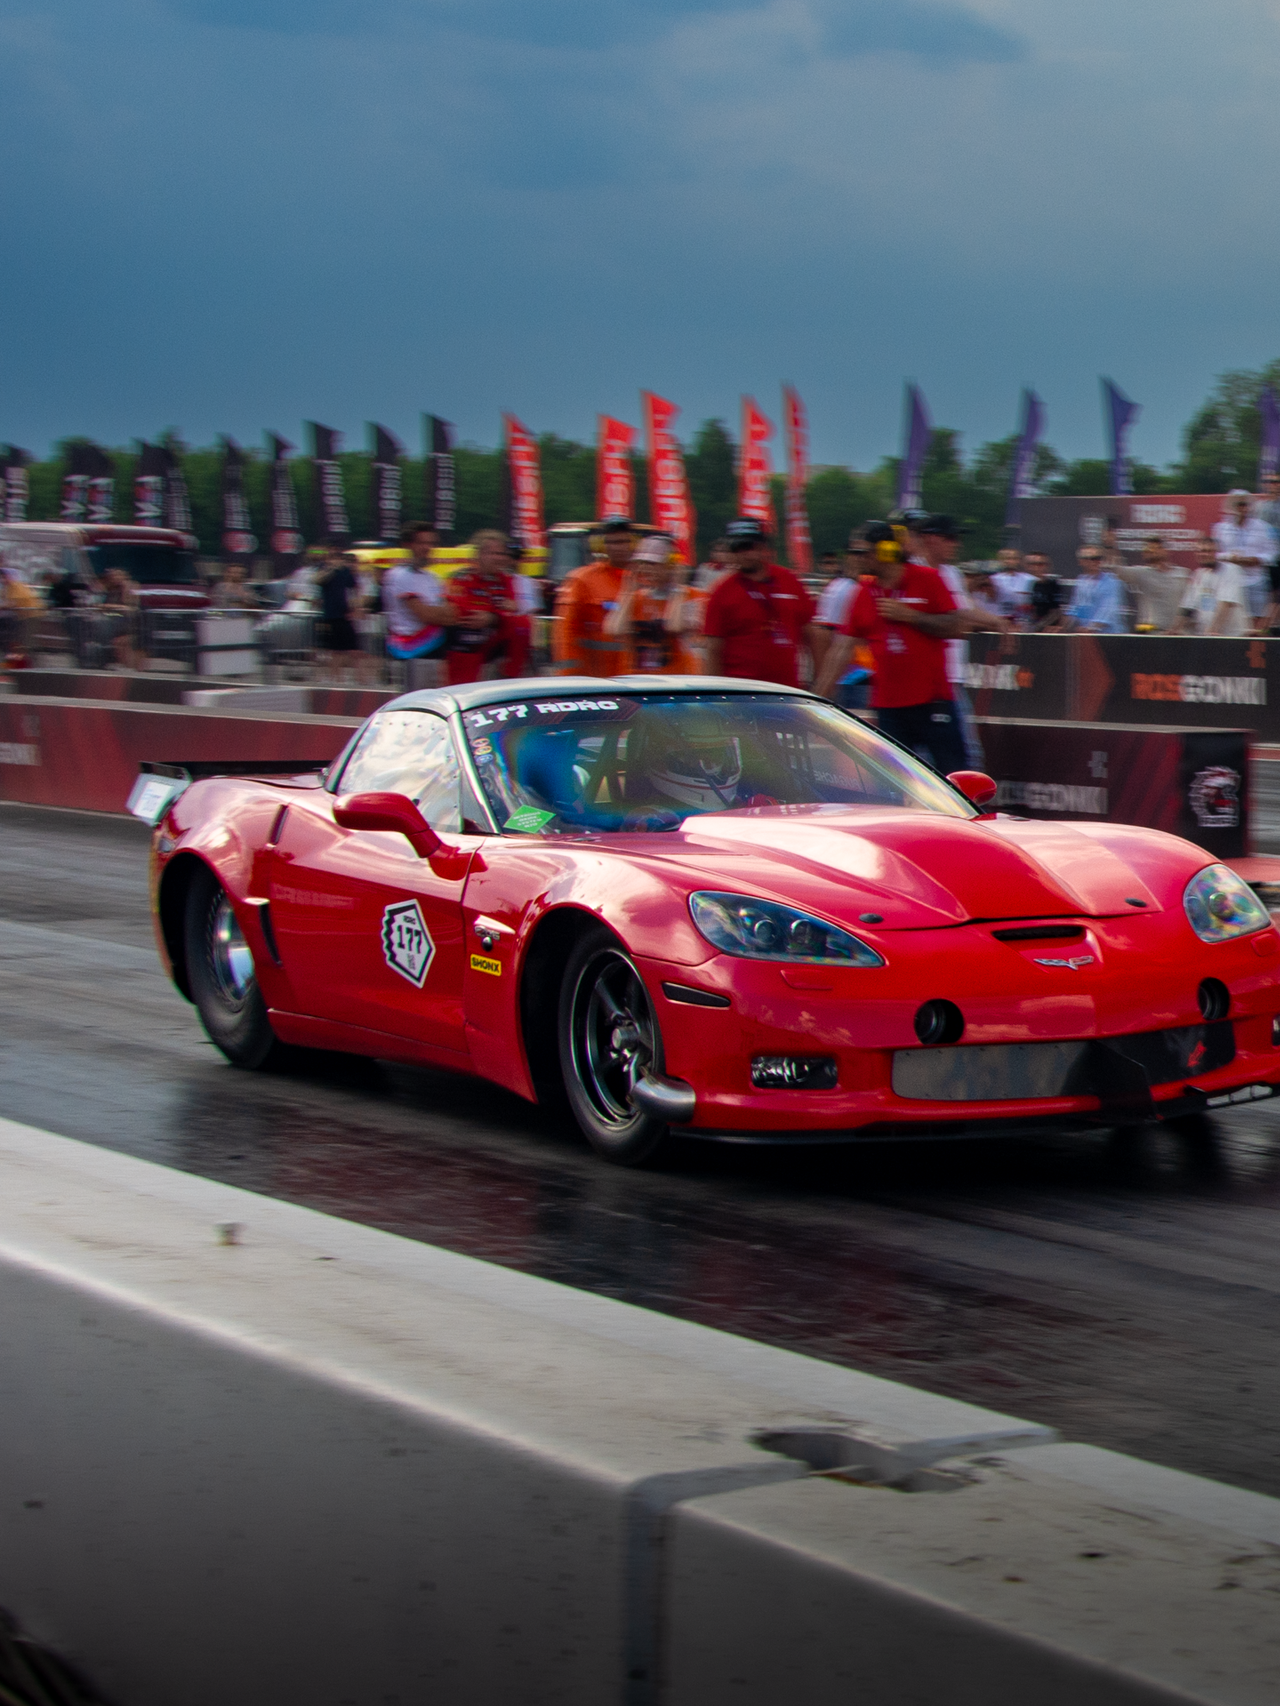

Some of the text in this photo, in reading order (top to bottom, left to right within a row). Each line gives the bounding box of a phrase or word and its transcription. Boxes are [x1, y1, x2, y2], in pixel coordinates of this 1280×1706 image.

[1131, 673, 1267, 705] ROSGONKI
[470, 704, 529, 728] 177
[397, 925, 422, 954] 177
